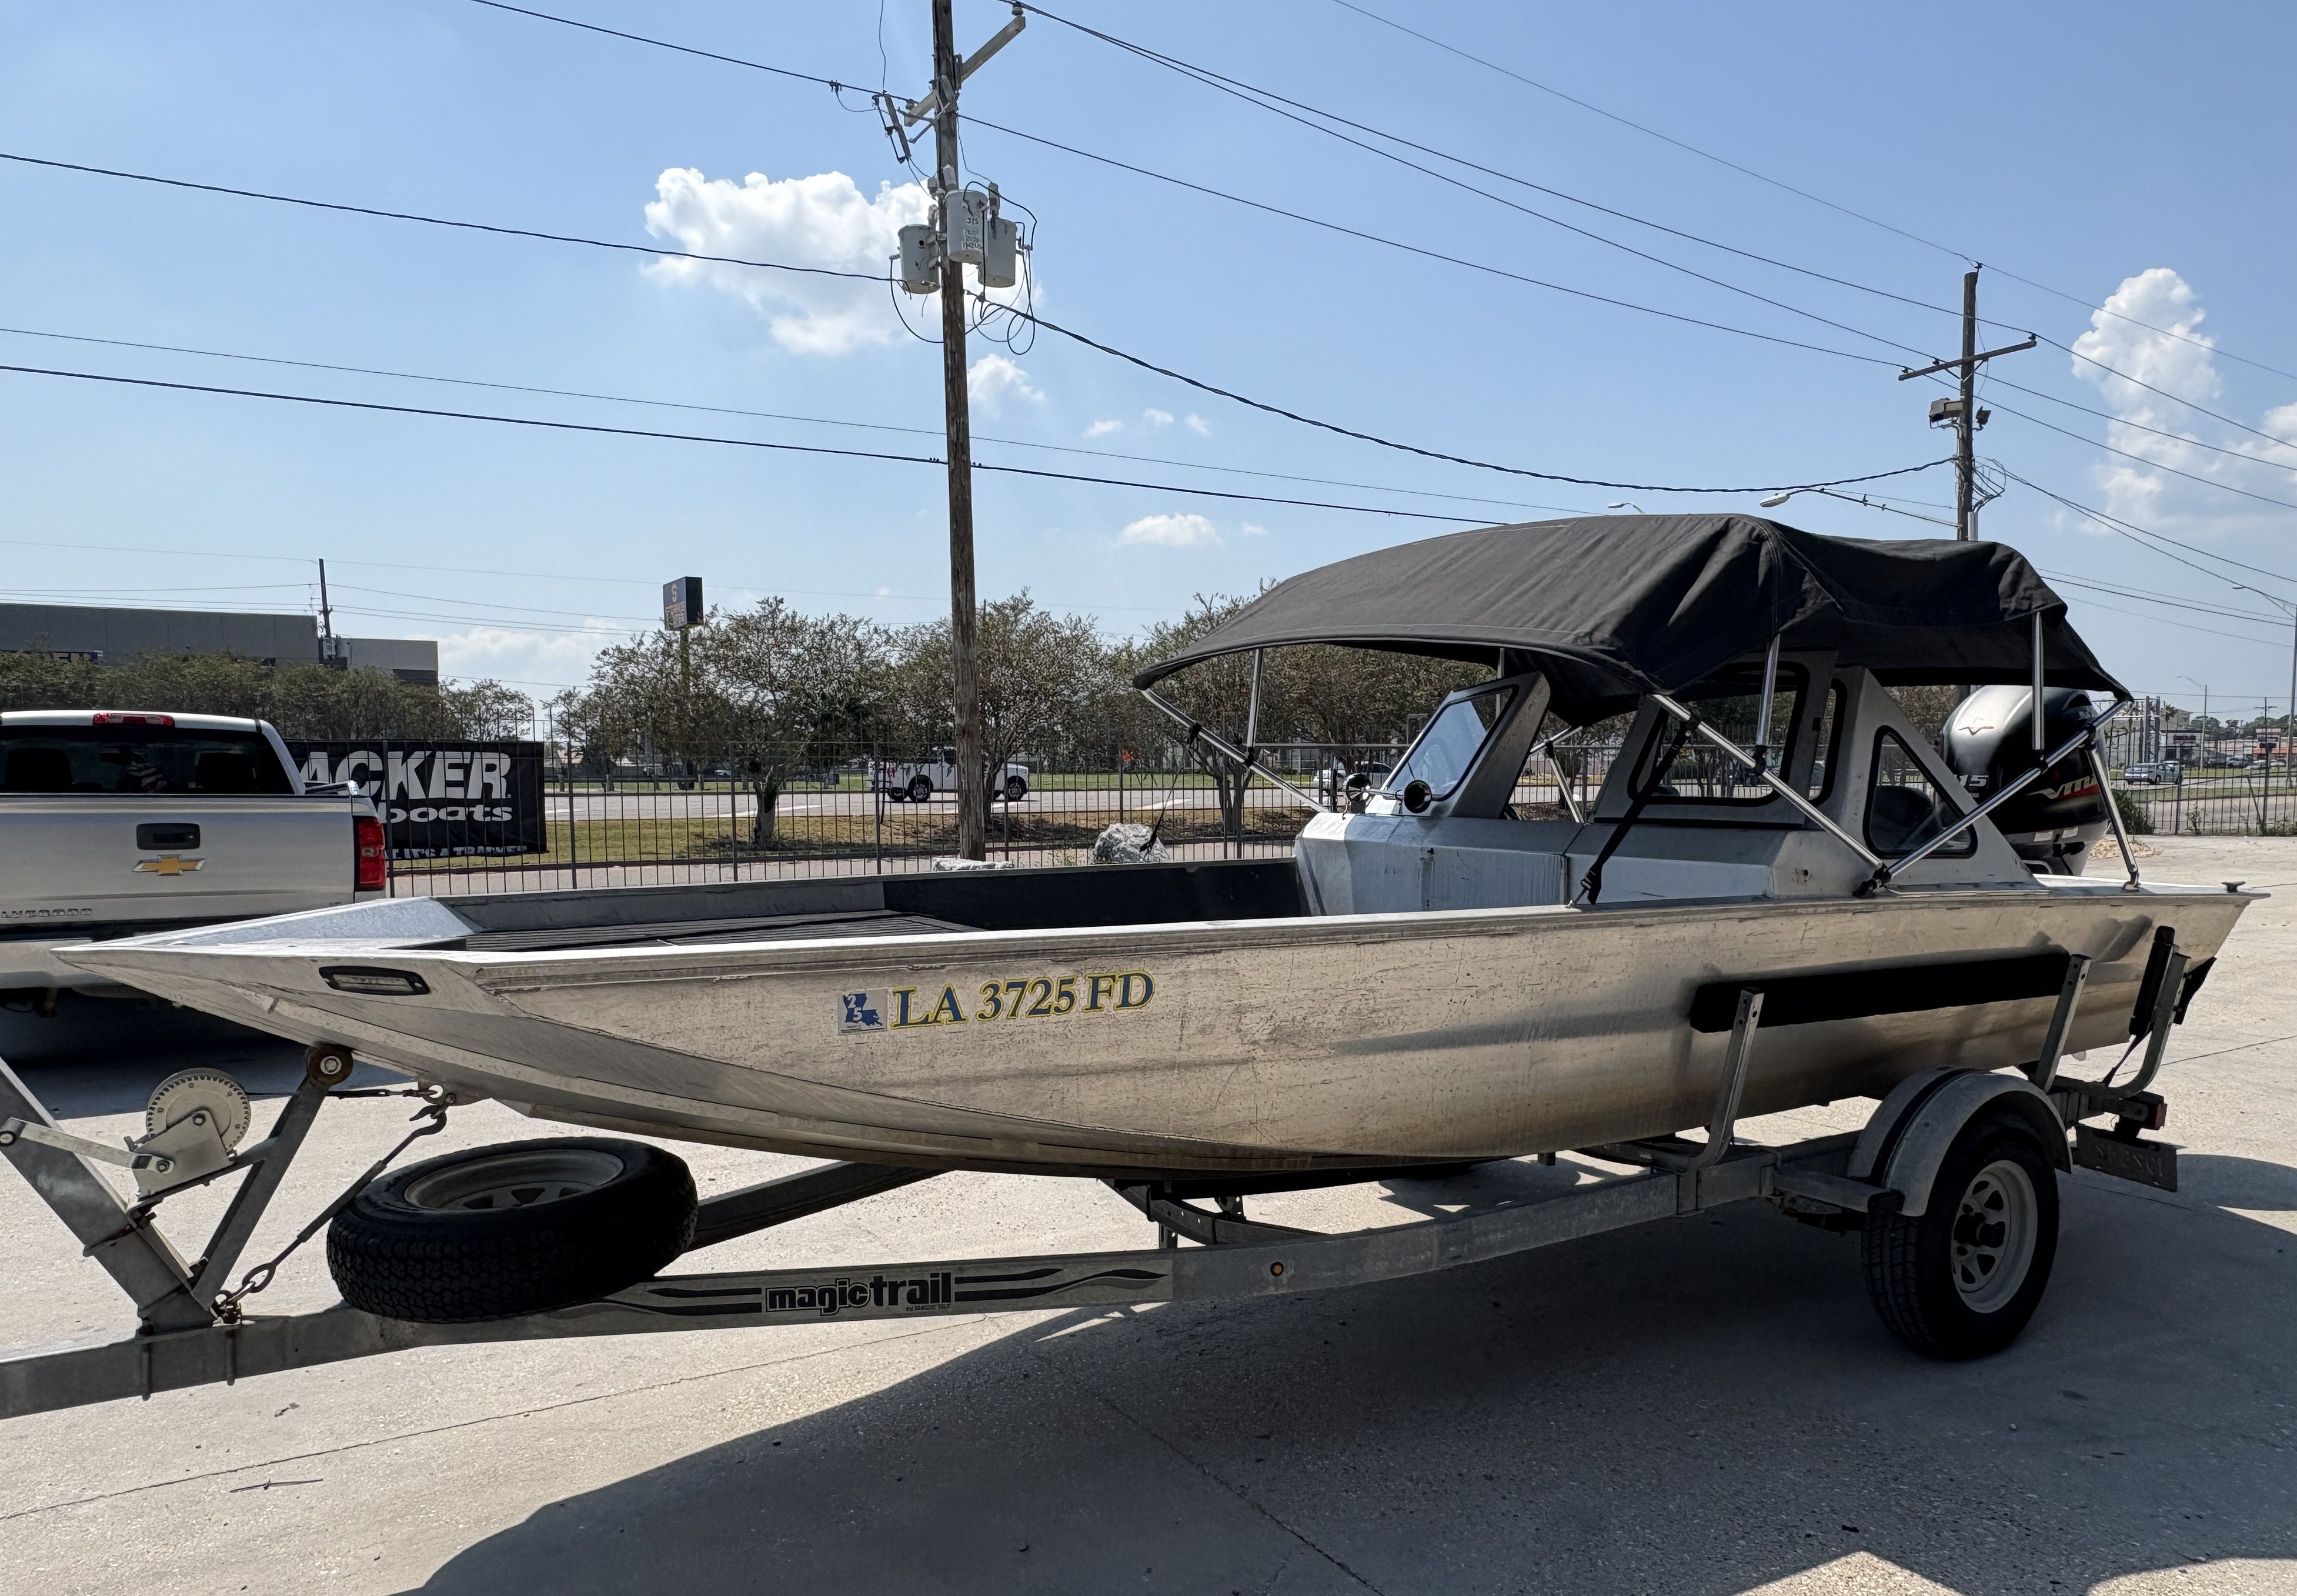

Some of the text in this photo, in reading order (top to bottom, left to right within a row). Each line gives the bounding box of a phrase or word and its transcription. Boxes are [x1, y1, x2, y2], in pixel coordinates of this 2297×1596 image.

[1953, 774, 1989, 787] 15
[378, 802, 512, 823] boats
[890, 970, 1156, 1030] LA 3725 FD
